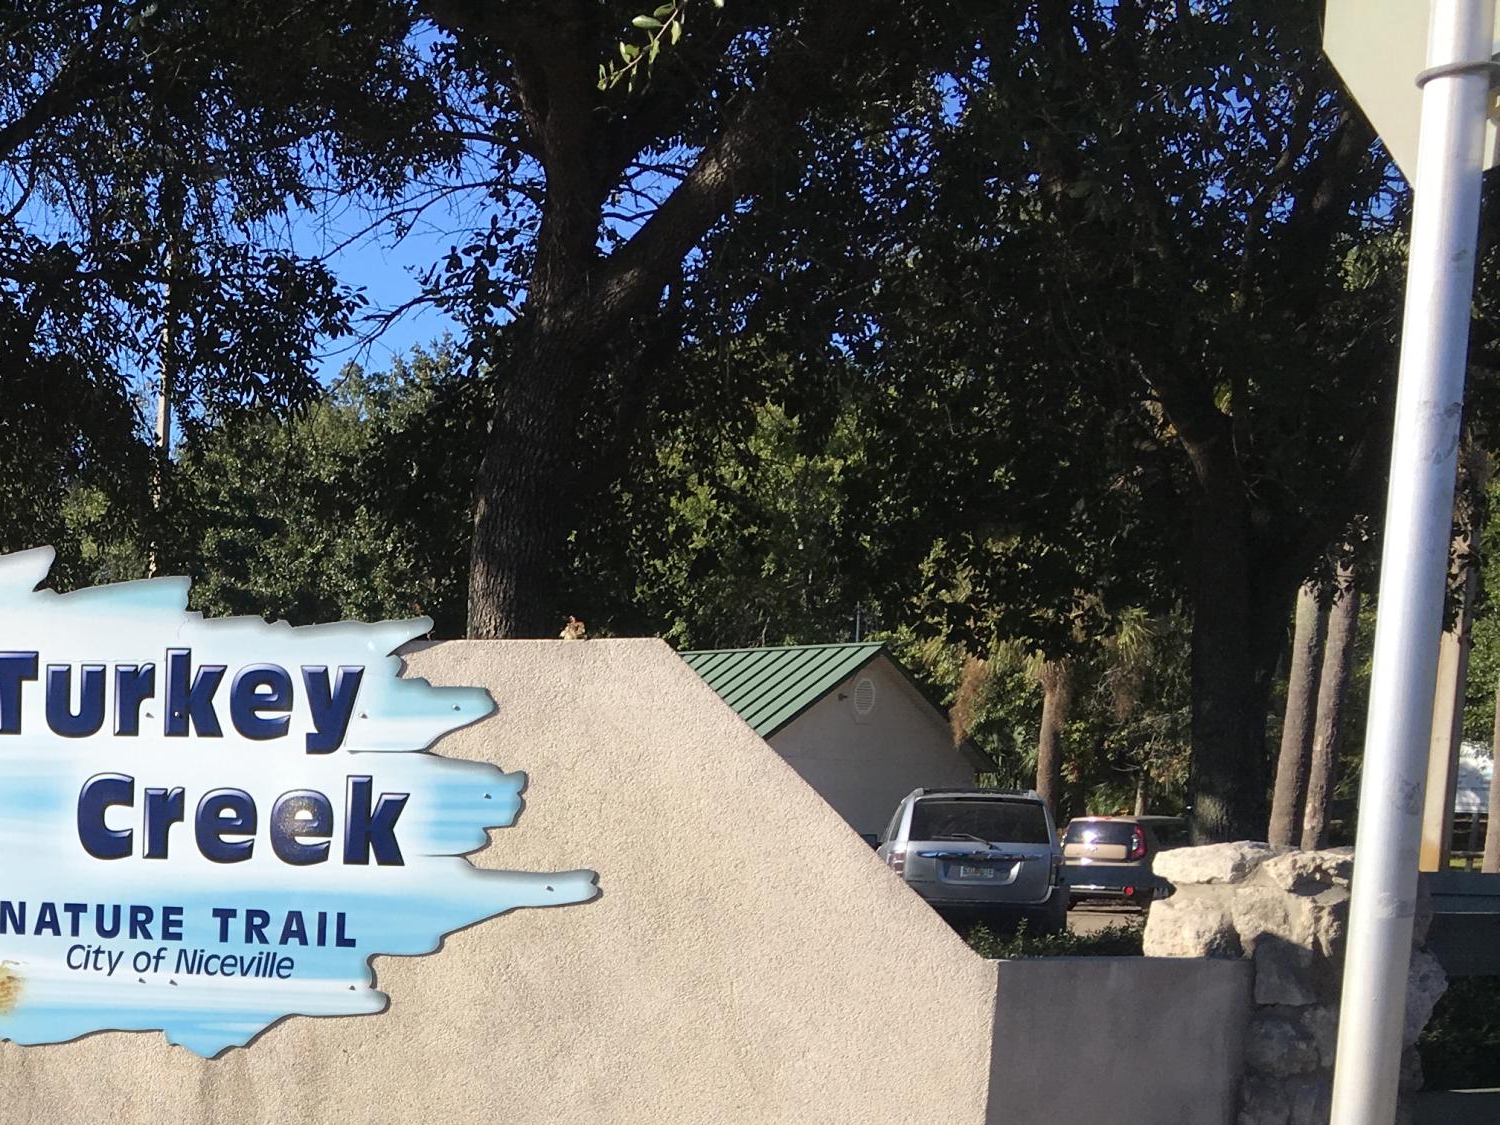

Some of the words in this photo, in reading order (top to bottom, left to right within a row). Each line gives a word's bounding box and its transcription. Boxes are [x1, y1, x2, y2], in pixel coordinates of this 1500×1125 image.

[76, 771, 411, 867] Creek
[0, 900, 184, 941] NATURE
[212, 908, 358, 948] TRAIL
[66, 944, 124, 977] City
[132, 946, 167, 974] of
[175, 947, 295, 979] Niceville
